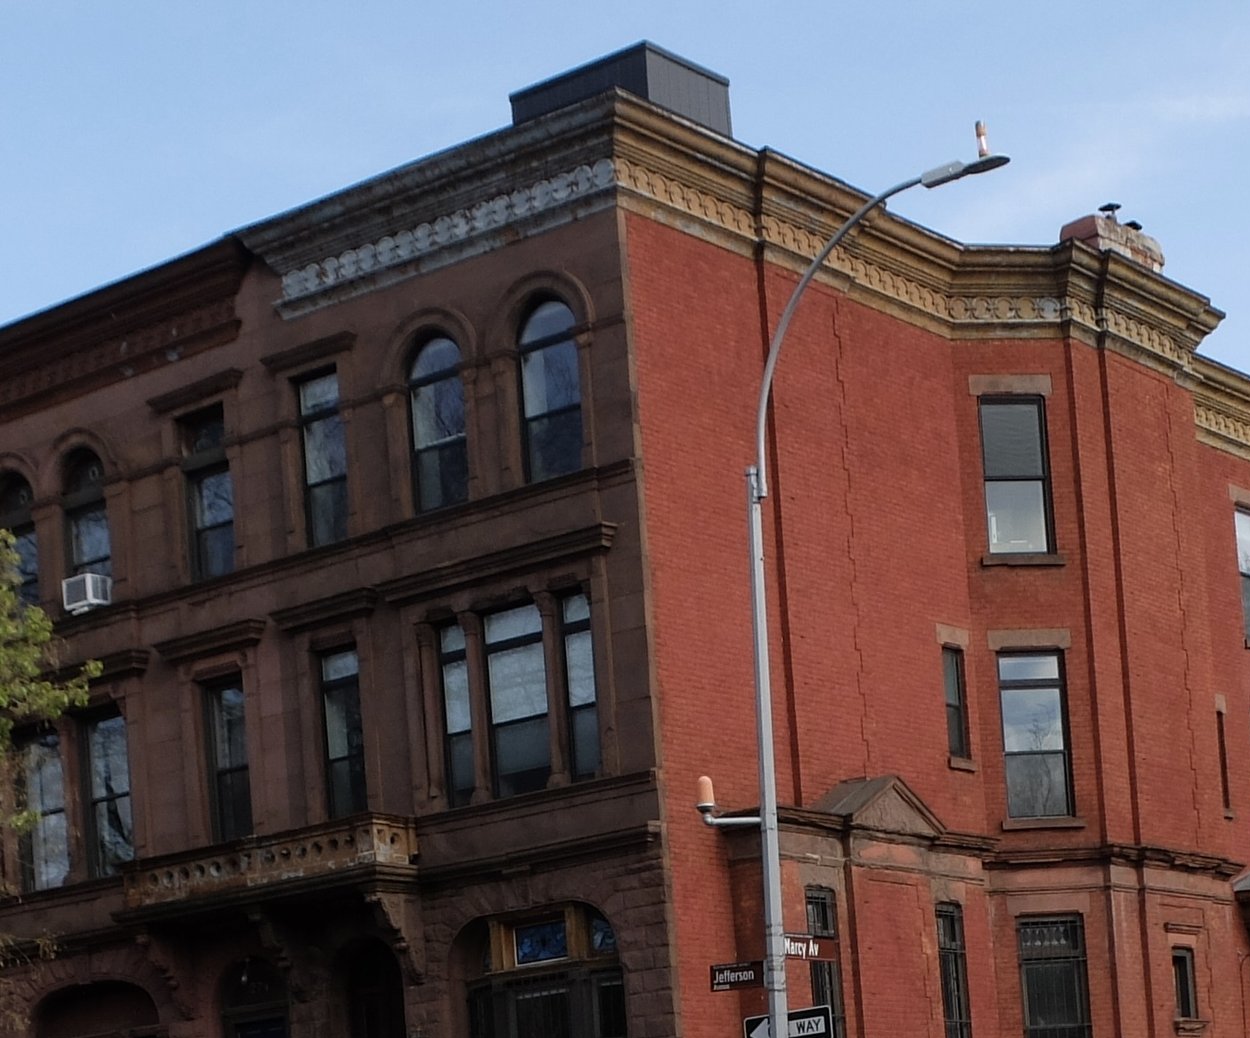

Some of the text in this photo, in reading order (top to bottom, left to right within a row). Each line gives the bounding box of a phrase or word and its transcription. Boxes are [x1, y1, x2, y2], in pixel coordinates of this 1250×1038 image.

[809, 939, 819, 956] Av
[713, 970, 754, 984] Jefferson
[796, 1018, 822, 1034] WAY
